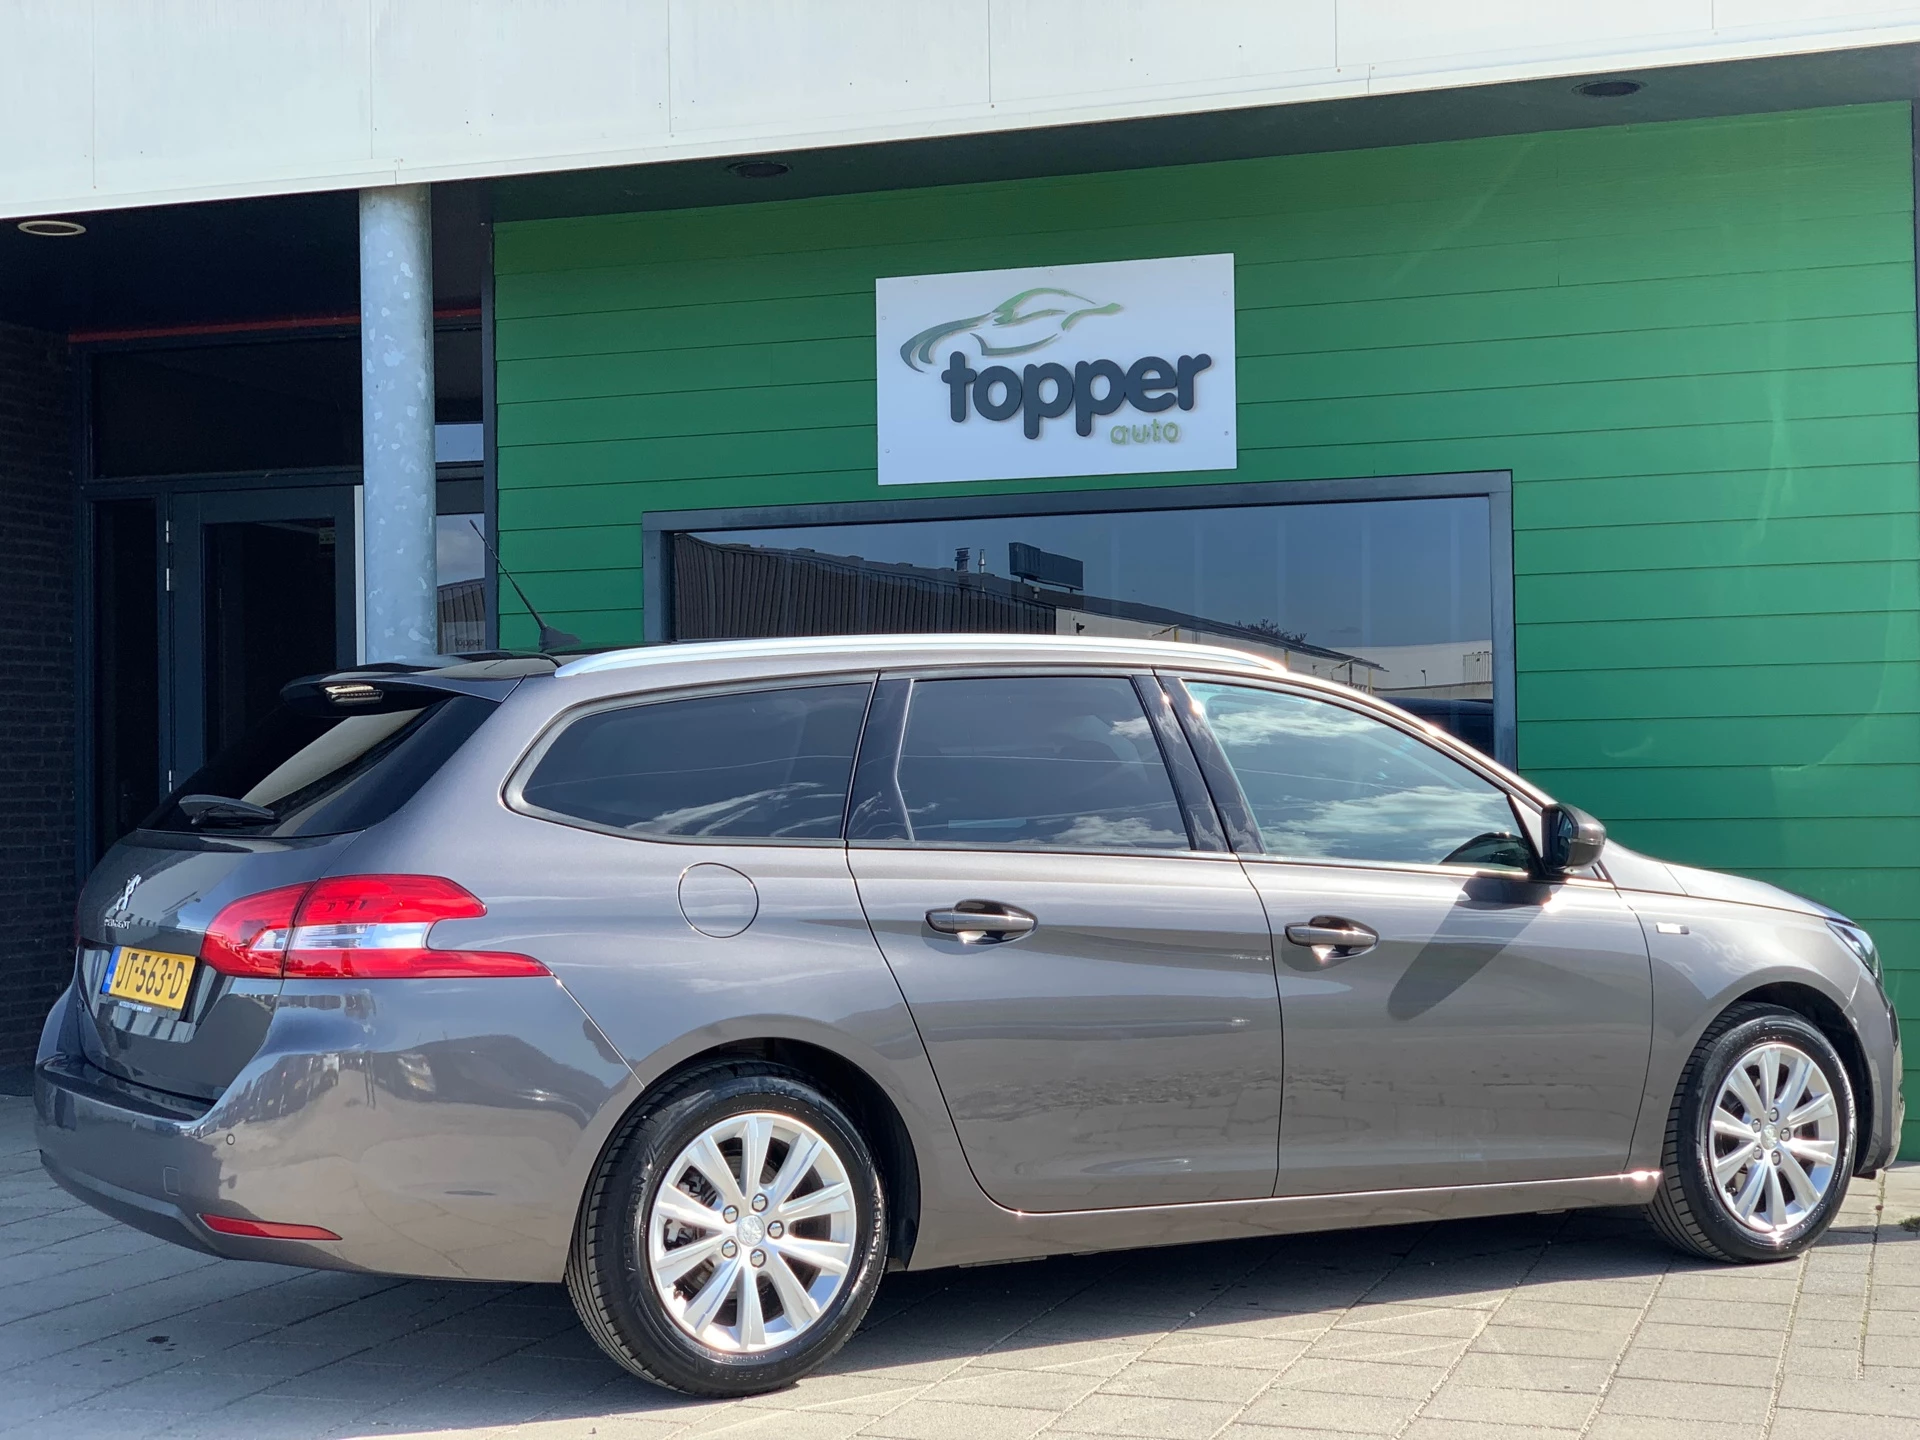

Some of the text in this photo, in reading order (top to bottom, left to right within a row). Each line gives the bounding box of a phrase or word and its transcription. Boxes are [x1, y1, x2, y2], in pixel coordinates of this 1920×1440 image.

[941, 351, 1212, 439] topper
[1110, 419, 1180, 445] auto
[455, 638, 484, 648] topper
[116, 952, 185, 1000] JT-563-D
